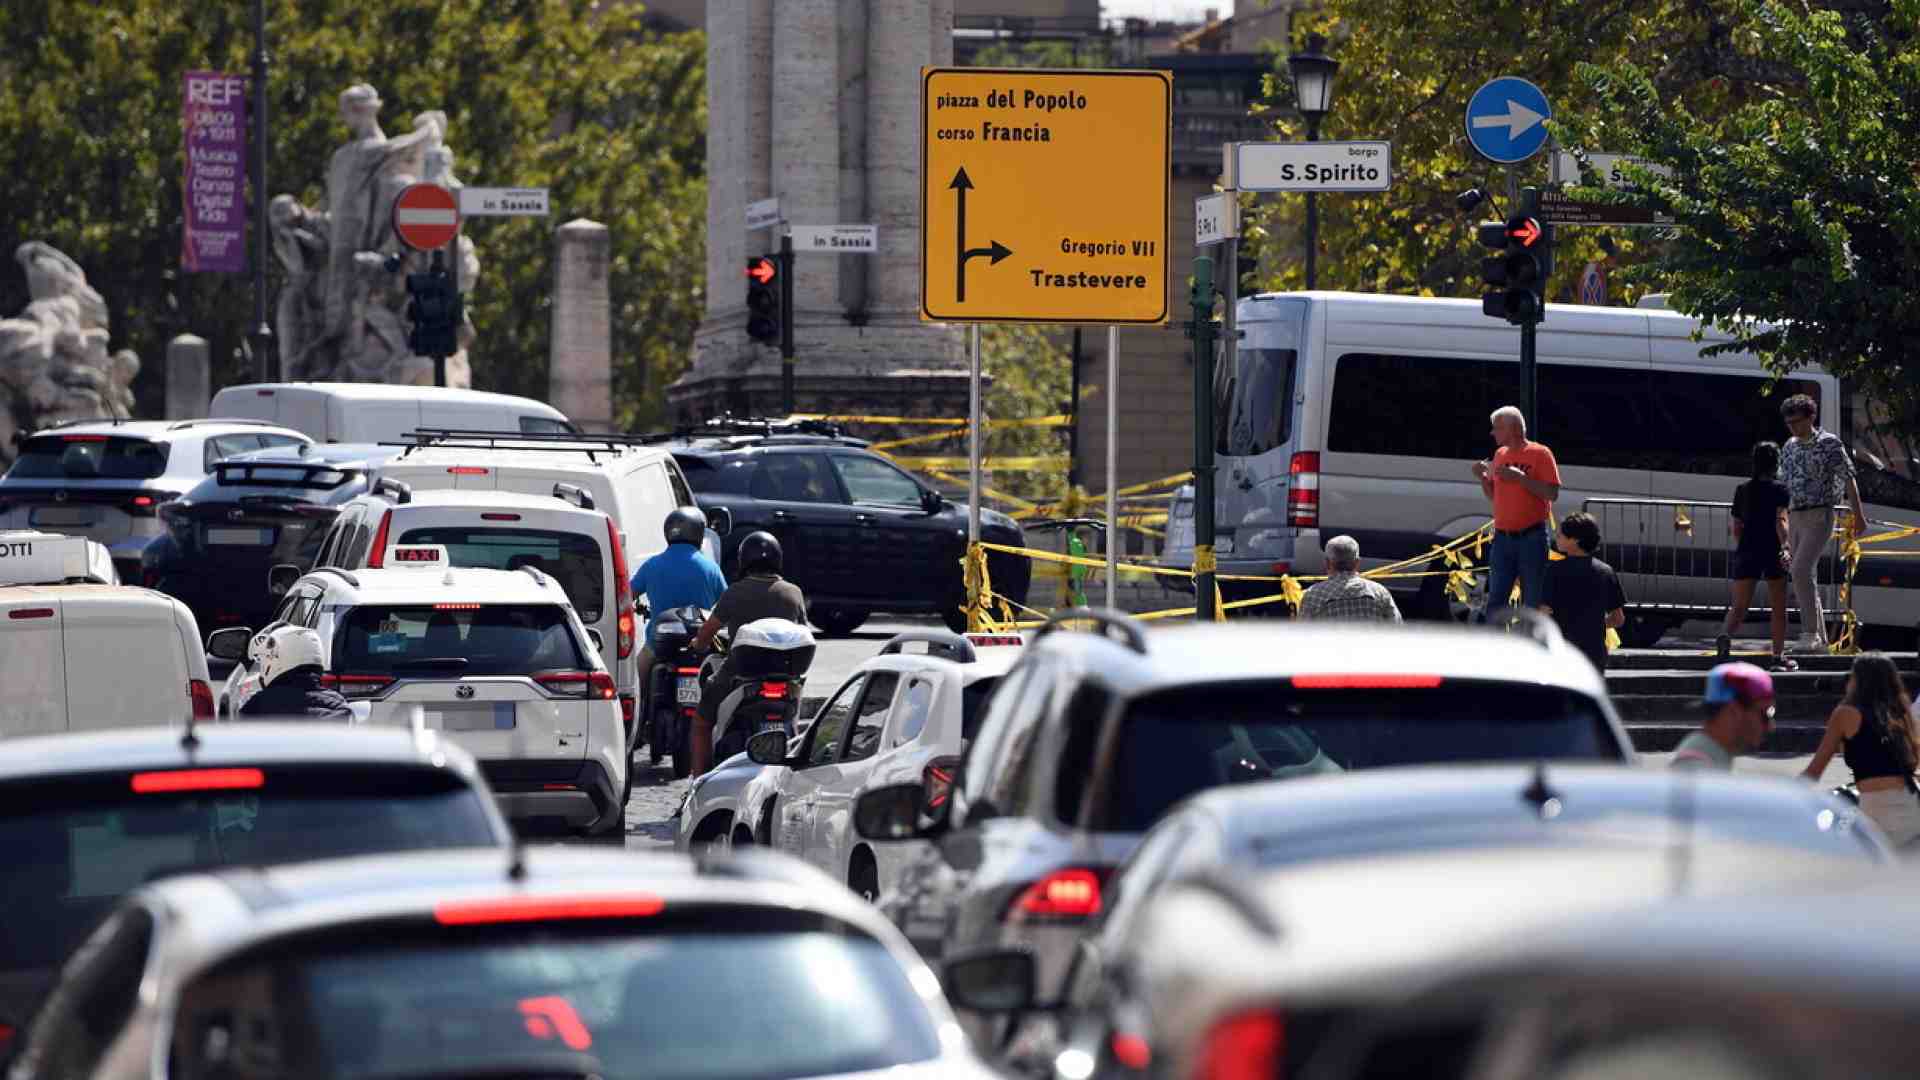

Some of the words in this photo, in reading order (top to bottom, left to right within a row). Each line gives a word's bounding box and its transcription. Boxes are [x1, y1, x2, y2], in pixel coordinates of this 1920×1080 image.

[188, 79, 242, 105] REF
[936, 92, 979, 110] piazza
[986, 89, 1016, 108] del
[1023, 89, 1087, 113] Popolo
[936, 127, 975, 140] corso
[982, 121, 1050, 142] Francia
[1348, 147, 1379, 159] borgo
[814, 235, 827, 247] in
[830, 235, 871, 247] Sassia
[1061, 237, 1126, 257] Gregorio
[1131, 241, 1155, 256] VII
[1029, 269, 1147, 288] Trastevere
[397, 549, 438, 561] TAXI
